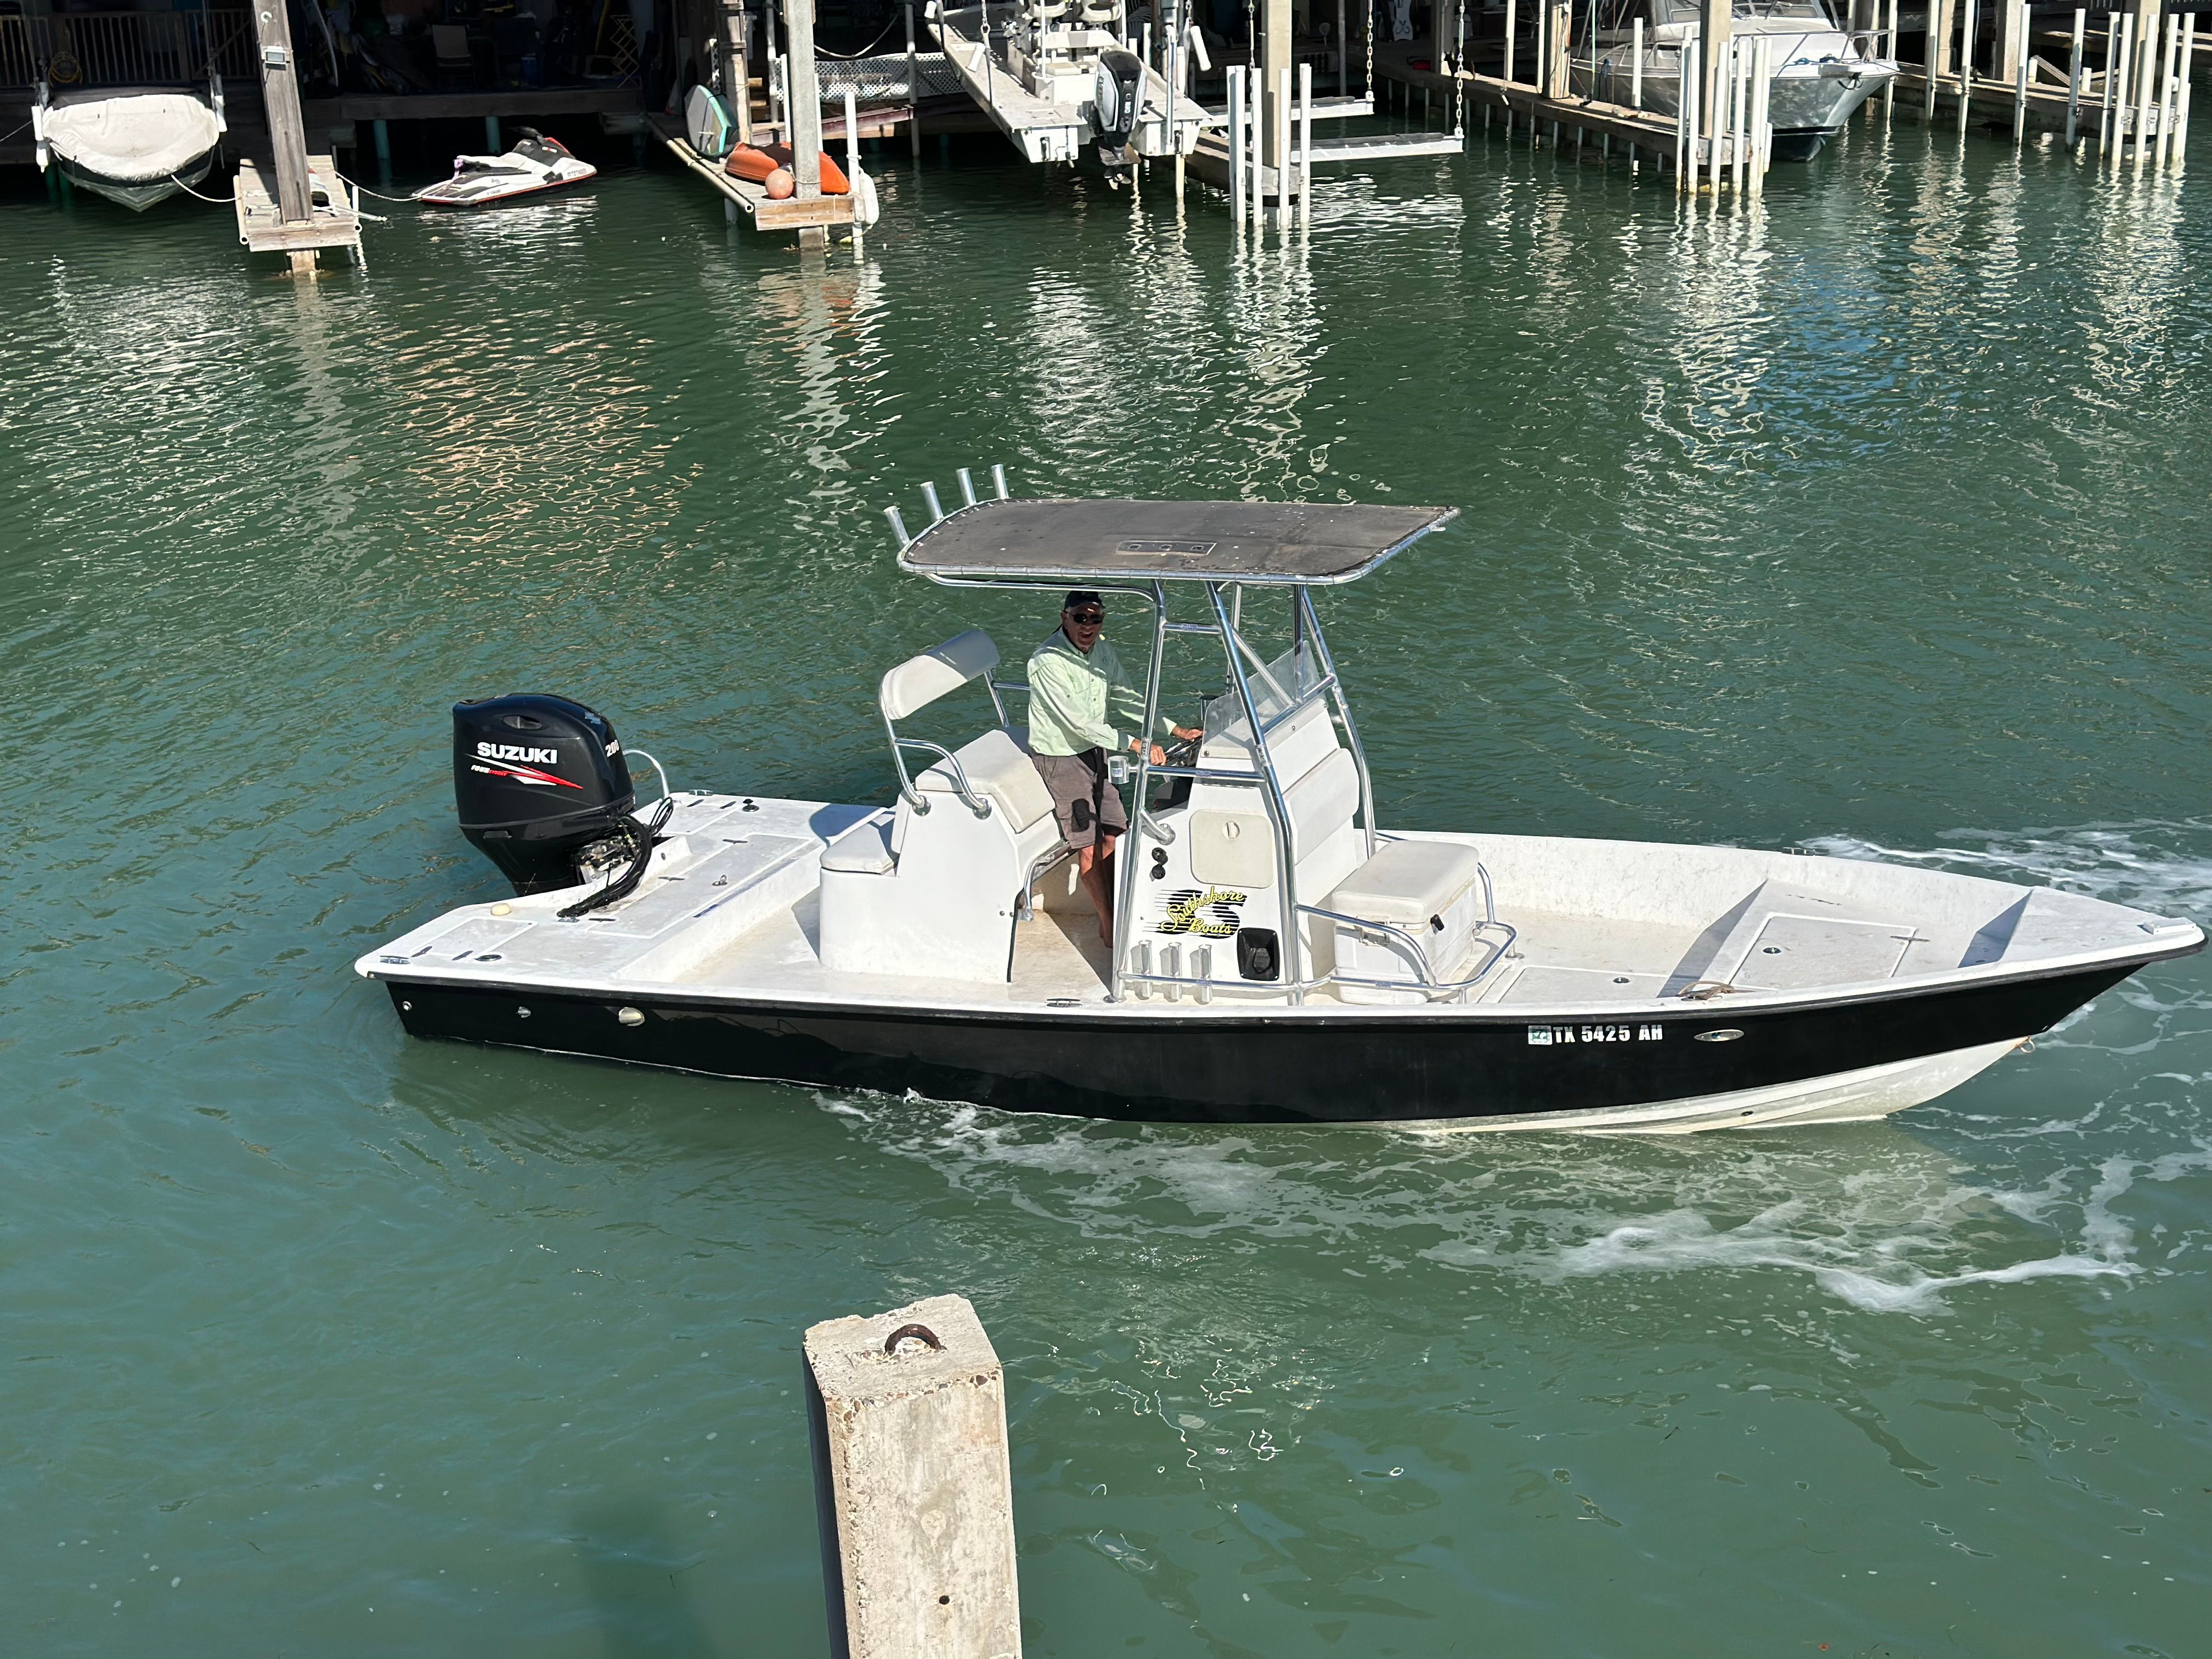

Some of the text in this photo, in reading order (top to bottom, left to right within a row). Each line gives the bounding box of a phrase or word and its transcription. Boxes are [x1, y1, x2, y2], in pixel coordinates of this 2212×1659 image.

[477, 742, 557, 764] SUZUKI
[1160, 886, 1244, 931] Southshore
[1189, 918, 1232, 934] Boats
[1553, 1026, 1576, 1043] TX
[1582, 1025, 1630, 1042] 5425
[1638, 1024, 1663, 1040] AH
